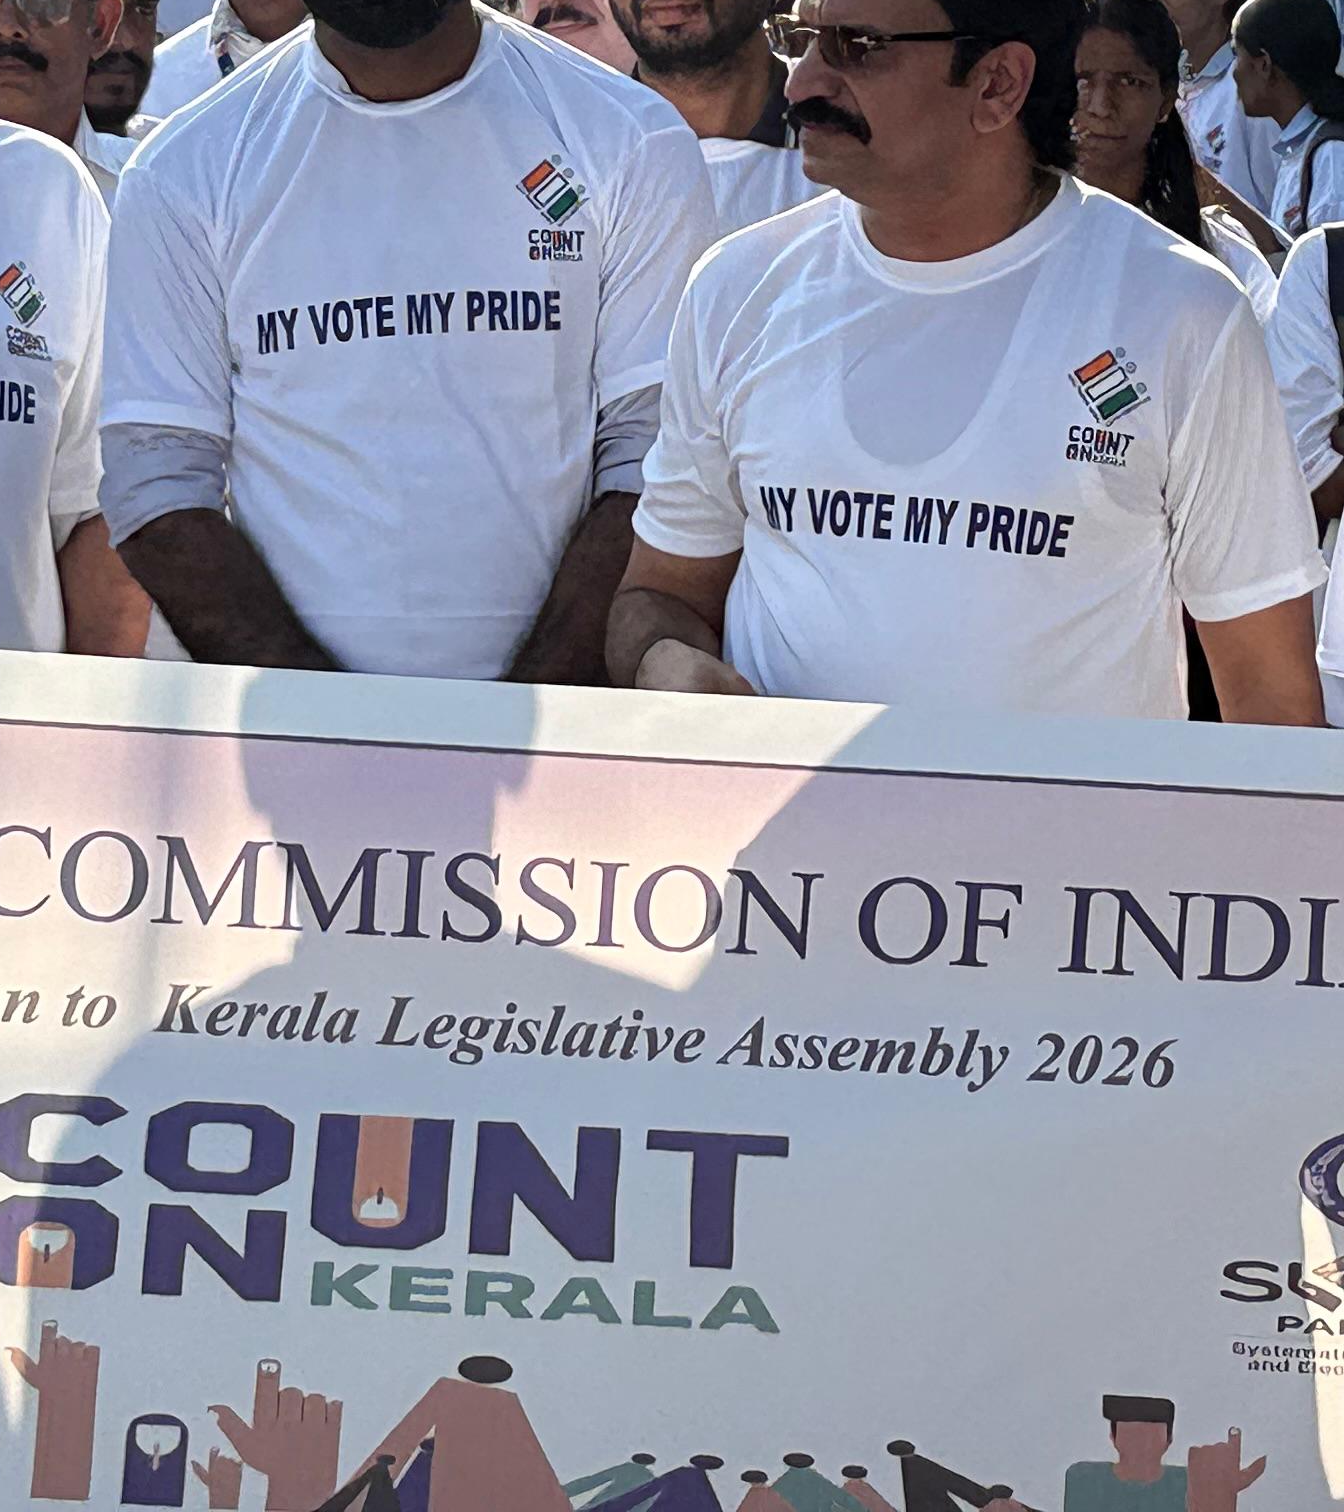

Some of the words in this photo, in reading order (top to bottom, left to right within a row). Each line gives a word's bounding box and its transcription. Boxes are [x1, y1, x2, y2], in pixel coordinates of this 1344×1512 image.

[528, 229, 585, 252] COUNT
[257, 309, 298, 355] MY
[309, 296, 394, 345] VOTE
[406, 292, 456, 336] MY
[466, 289, 561, 333] PRIDE
[1066, 444, 1092, 463] ON
[1068, 425, 1135, 458] COUNT
[760, 486, 797, 533] MY
[807, 488, 896, 541] VOTE
[903, 497, 960, 547] MY
[966, 505, 1075, 559] PRIDE
[857, 876, 1024, 968] OF
[63, 985, 117, 1030] to
[152, 982, 360, 1045] Kerala
[376, 995, 706, 1066] Legislative
[717, 1015, 1010, 1093] Assembly
[1026, 1031, 1180, 1090] 2026
[309, 1260, 781, 1334] KERALA
[1248, 1358, 1290, 1373] and
